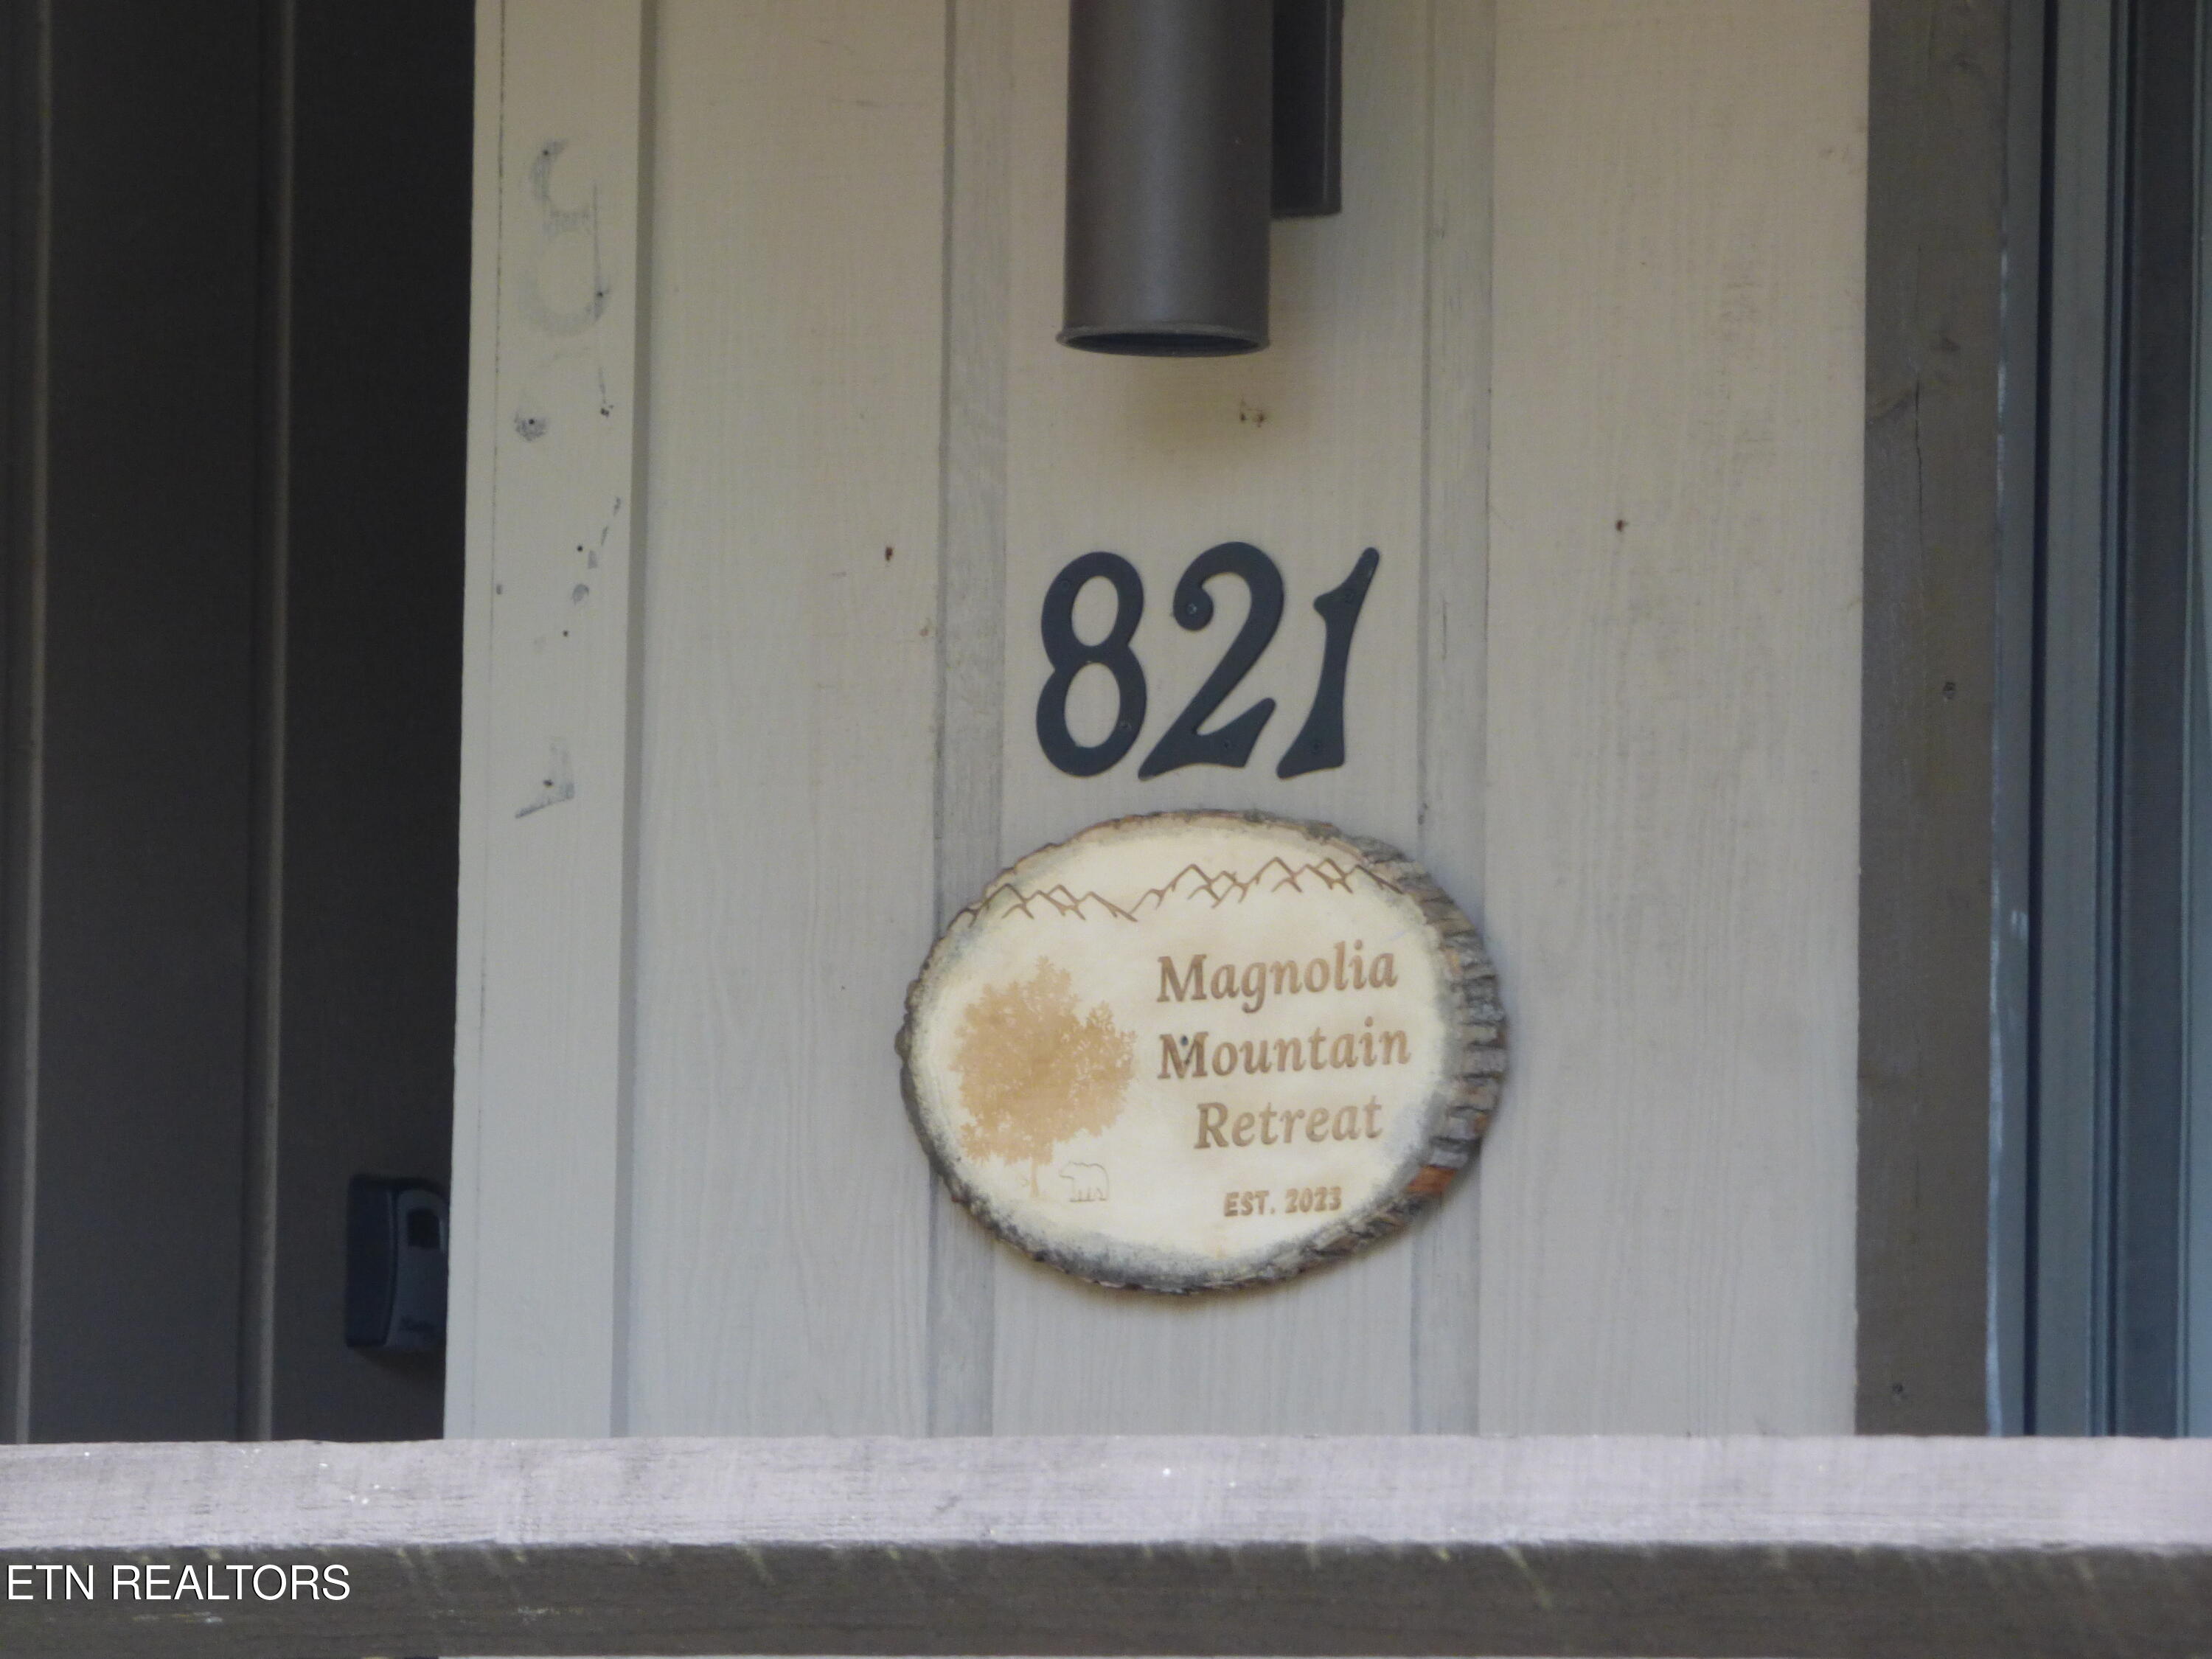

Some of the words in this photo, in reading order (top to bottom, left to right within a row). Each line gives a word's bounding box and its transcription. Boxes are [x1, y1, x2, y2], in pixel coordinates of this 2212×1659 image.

[1037, 541, 1380, 779] 821
[1156, 939, 1398, 1013] Magnolia
[1157, 1016, 1412, 1079] Mountain
[1194, 1095, 1383, 1150] Retreat
[1224, 1191, 1276, 1217] EST.
[1285, 1186, 1342, 1214] 2023
